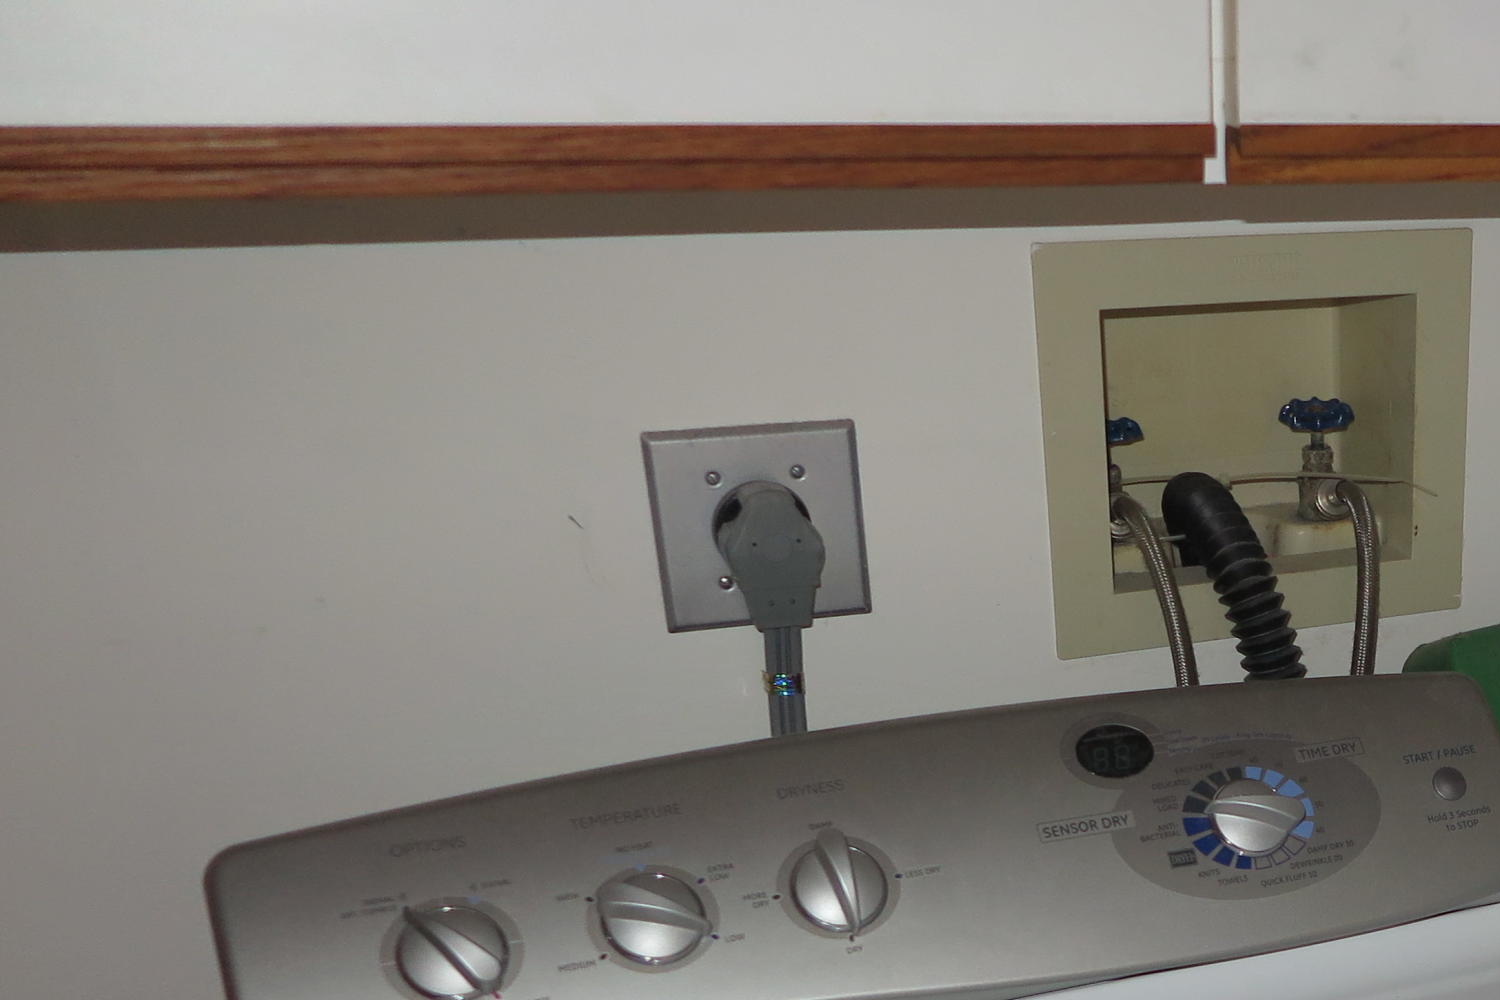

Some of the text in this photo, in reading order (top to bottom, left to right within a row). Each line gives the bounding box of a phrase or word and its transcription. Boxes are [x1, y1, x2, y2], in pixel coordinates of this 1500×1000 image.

[1298, 742, 1357, 762] TIME DRY
[1402, 751, 1434, 765] START
[1443, 744, 1477, 759] PAUSE
[775, 778, 845, 800] DRYNESS
[569, 803, 682, 830] TEMPERATURE
[1427, 811, 1448, 824] Hold
[1455, 804, 1492, 819] Seconds
[1042, 814, 1130, 840] SENSOR DRY
[1457, 818, 1479, 831] STOP
[725, 932, 746, 944] LOW
